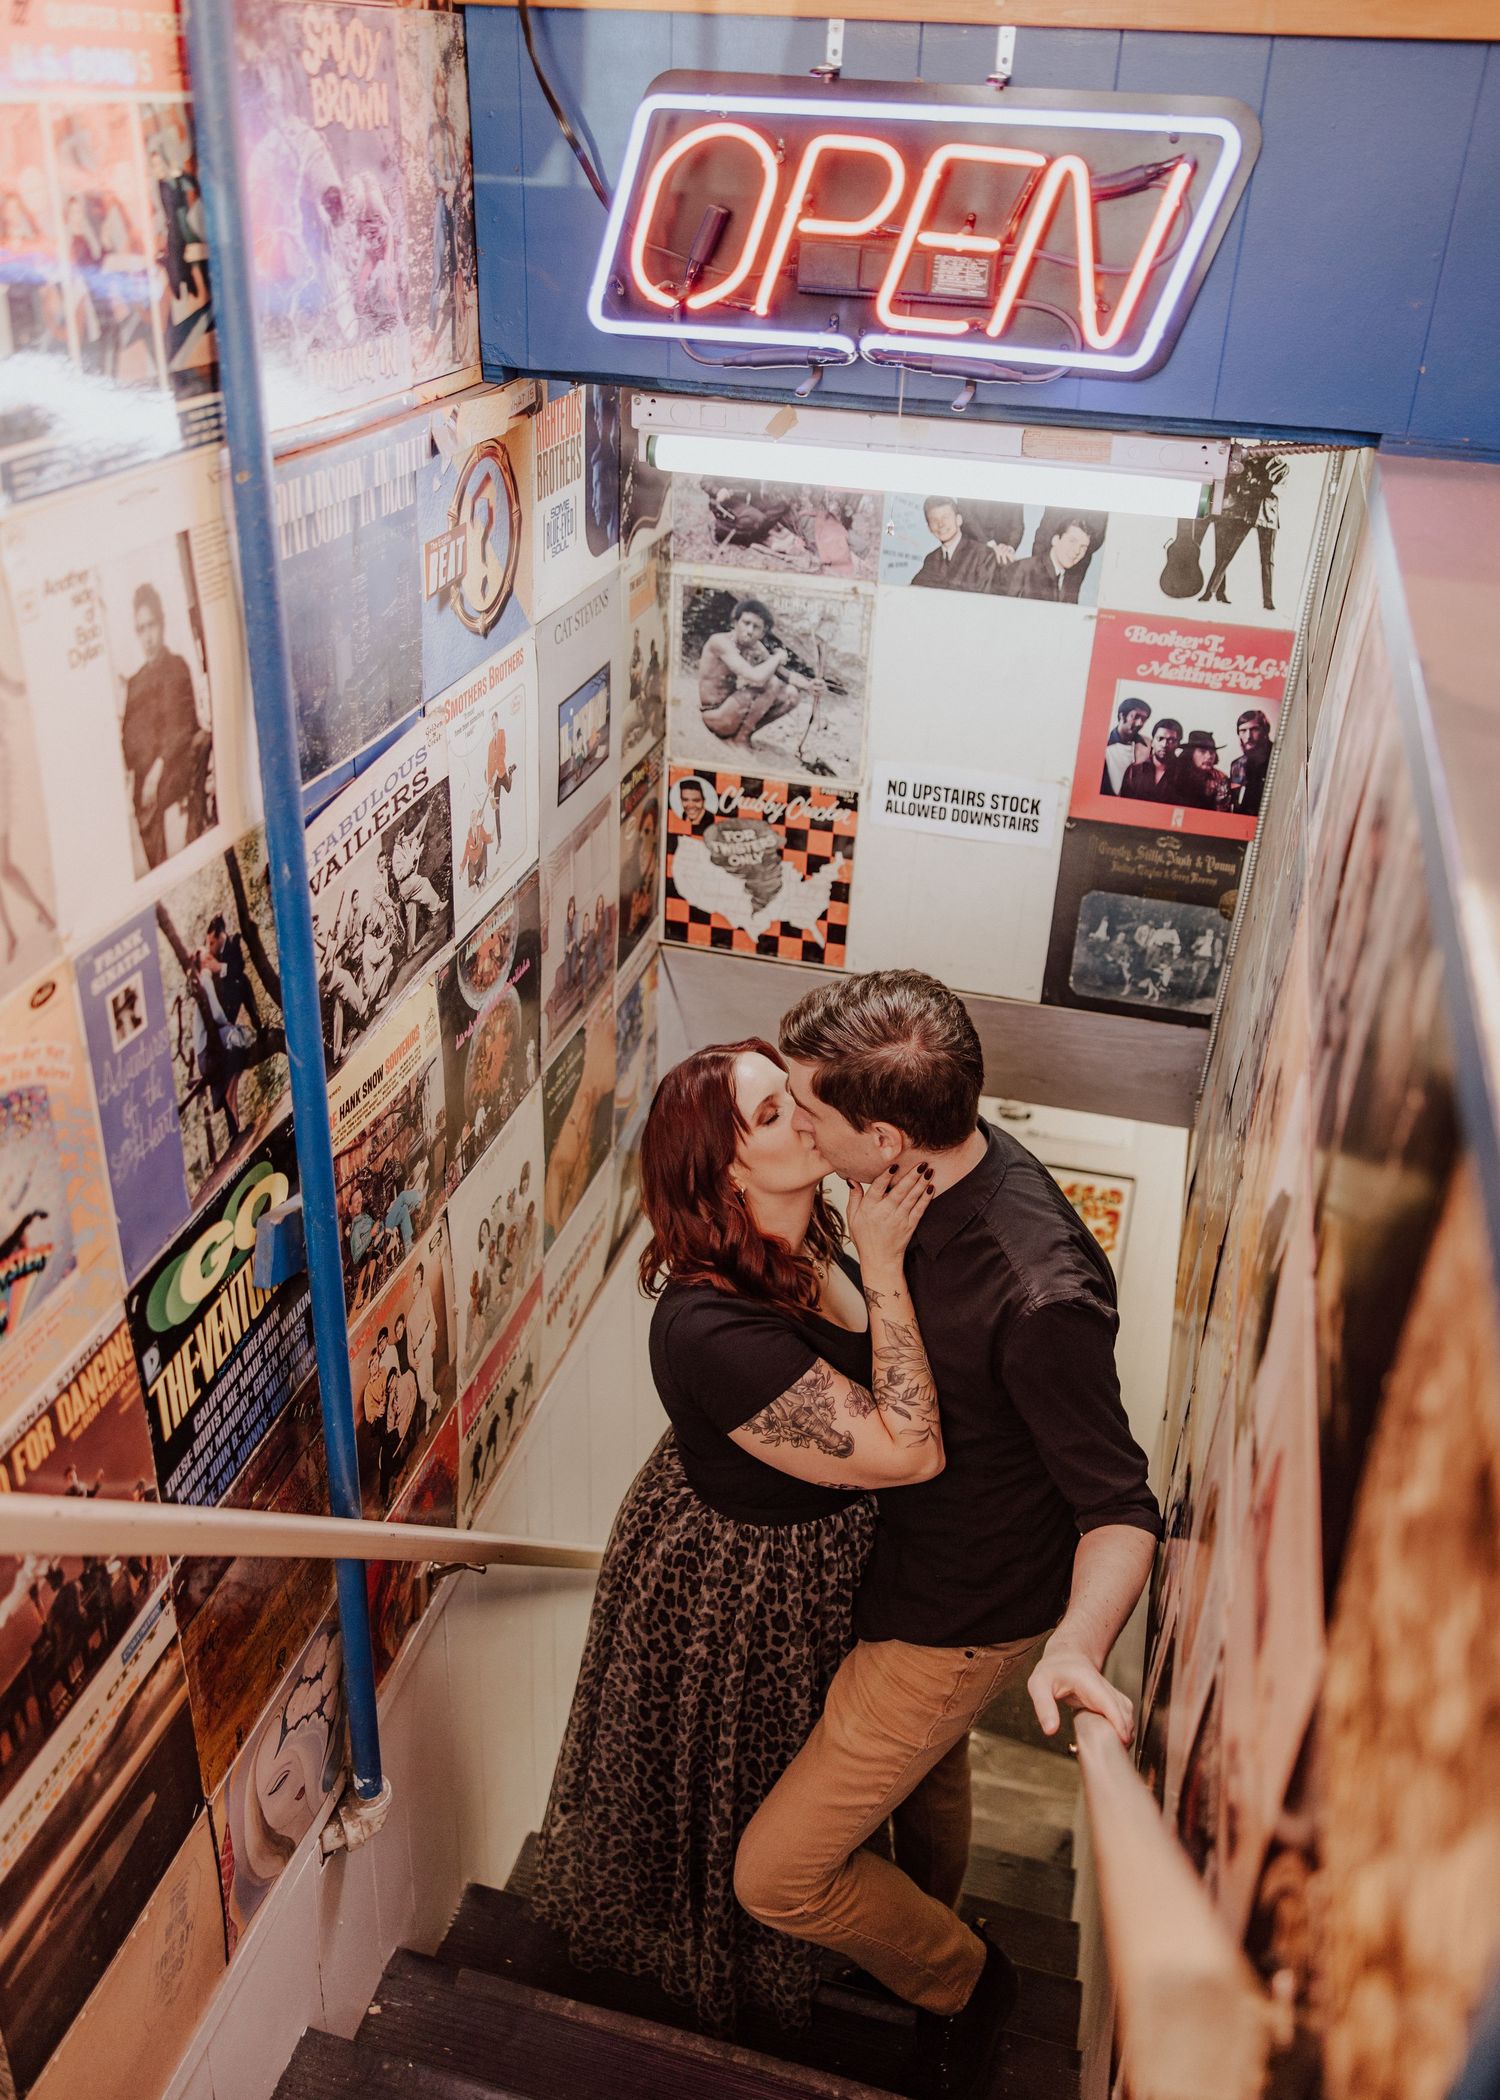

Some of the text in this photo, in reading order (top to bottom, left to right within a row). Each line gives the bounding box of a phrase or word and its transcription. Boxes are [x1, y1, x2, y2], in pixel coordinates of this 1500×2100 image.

[302, 4, 382, 81] SAVOY
[310, 72, 390, 131] BROWN
[631, 121, 1197, 350] OPEN
[536, 434, 582, 502] BROTHERS
[550, 499, 570, 520] SOME
[551, 542, 570, 558] SOUL
[554, 588, 609, 645] CAT STEVENS
[1125, 625, 1225, 653] Booker T.
[443, 647, 525, 726] SMOTHERS BROTHERS
[1136, 661, 1264, 691] Melting Pot
[1168, 649, 1191, 664] &
[1191, 650, 1232, 671] The
[311, 744, 428, 867] FABULOUS
[719, 785, 853, 826] Chubby Checker
[885, 799, 1040, 833] ALLOWED DOWNSTAIRS
[887, 780, 1041, 816] NO UPSTAIRS STOCK
[728, 851, 765, 867] ONLY
[338, 1089, 361, 1122] HANK
[360, 1064, 385, 1099] SNOW
[165, 1165, 290, 1318] GO
[191, 1303, 280, 1433] CALIFORNIA DREAMIN'
[252, 1353, 281, 1395] GREEN
[278, 1317, 306, 1360] GRASS
[13, 1415, 56, 1487] FOR
[55, 1321, 135, 1438] DANCING
[148, 1350, 203, 1443] THE
[164, 1449, 197, 1497] THESE
[192, 1410, 223, 1456] BOOTS
[221, 1384, 242, 1418] ARE
[239, 1350, 266, 1391] MADE
[264, 1328, 283, 1358] FOR
[187, 1474, 211, 1504] LOOP
[208, 1445, 232, 1485] JOHN
[243, 1393, 268, 1434] EIGHT
[266, 1361, 290, 1400] MILES
[215, 1461, 235, 1495] AND
[233, 1414, 268, 1468] JOHNNY
